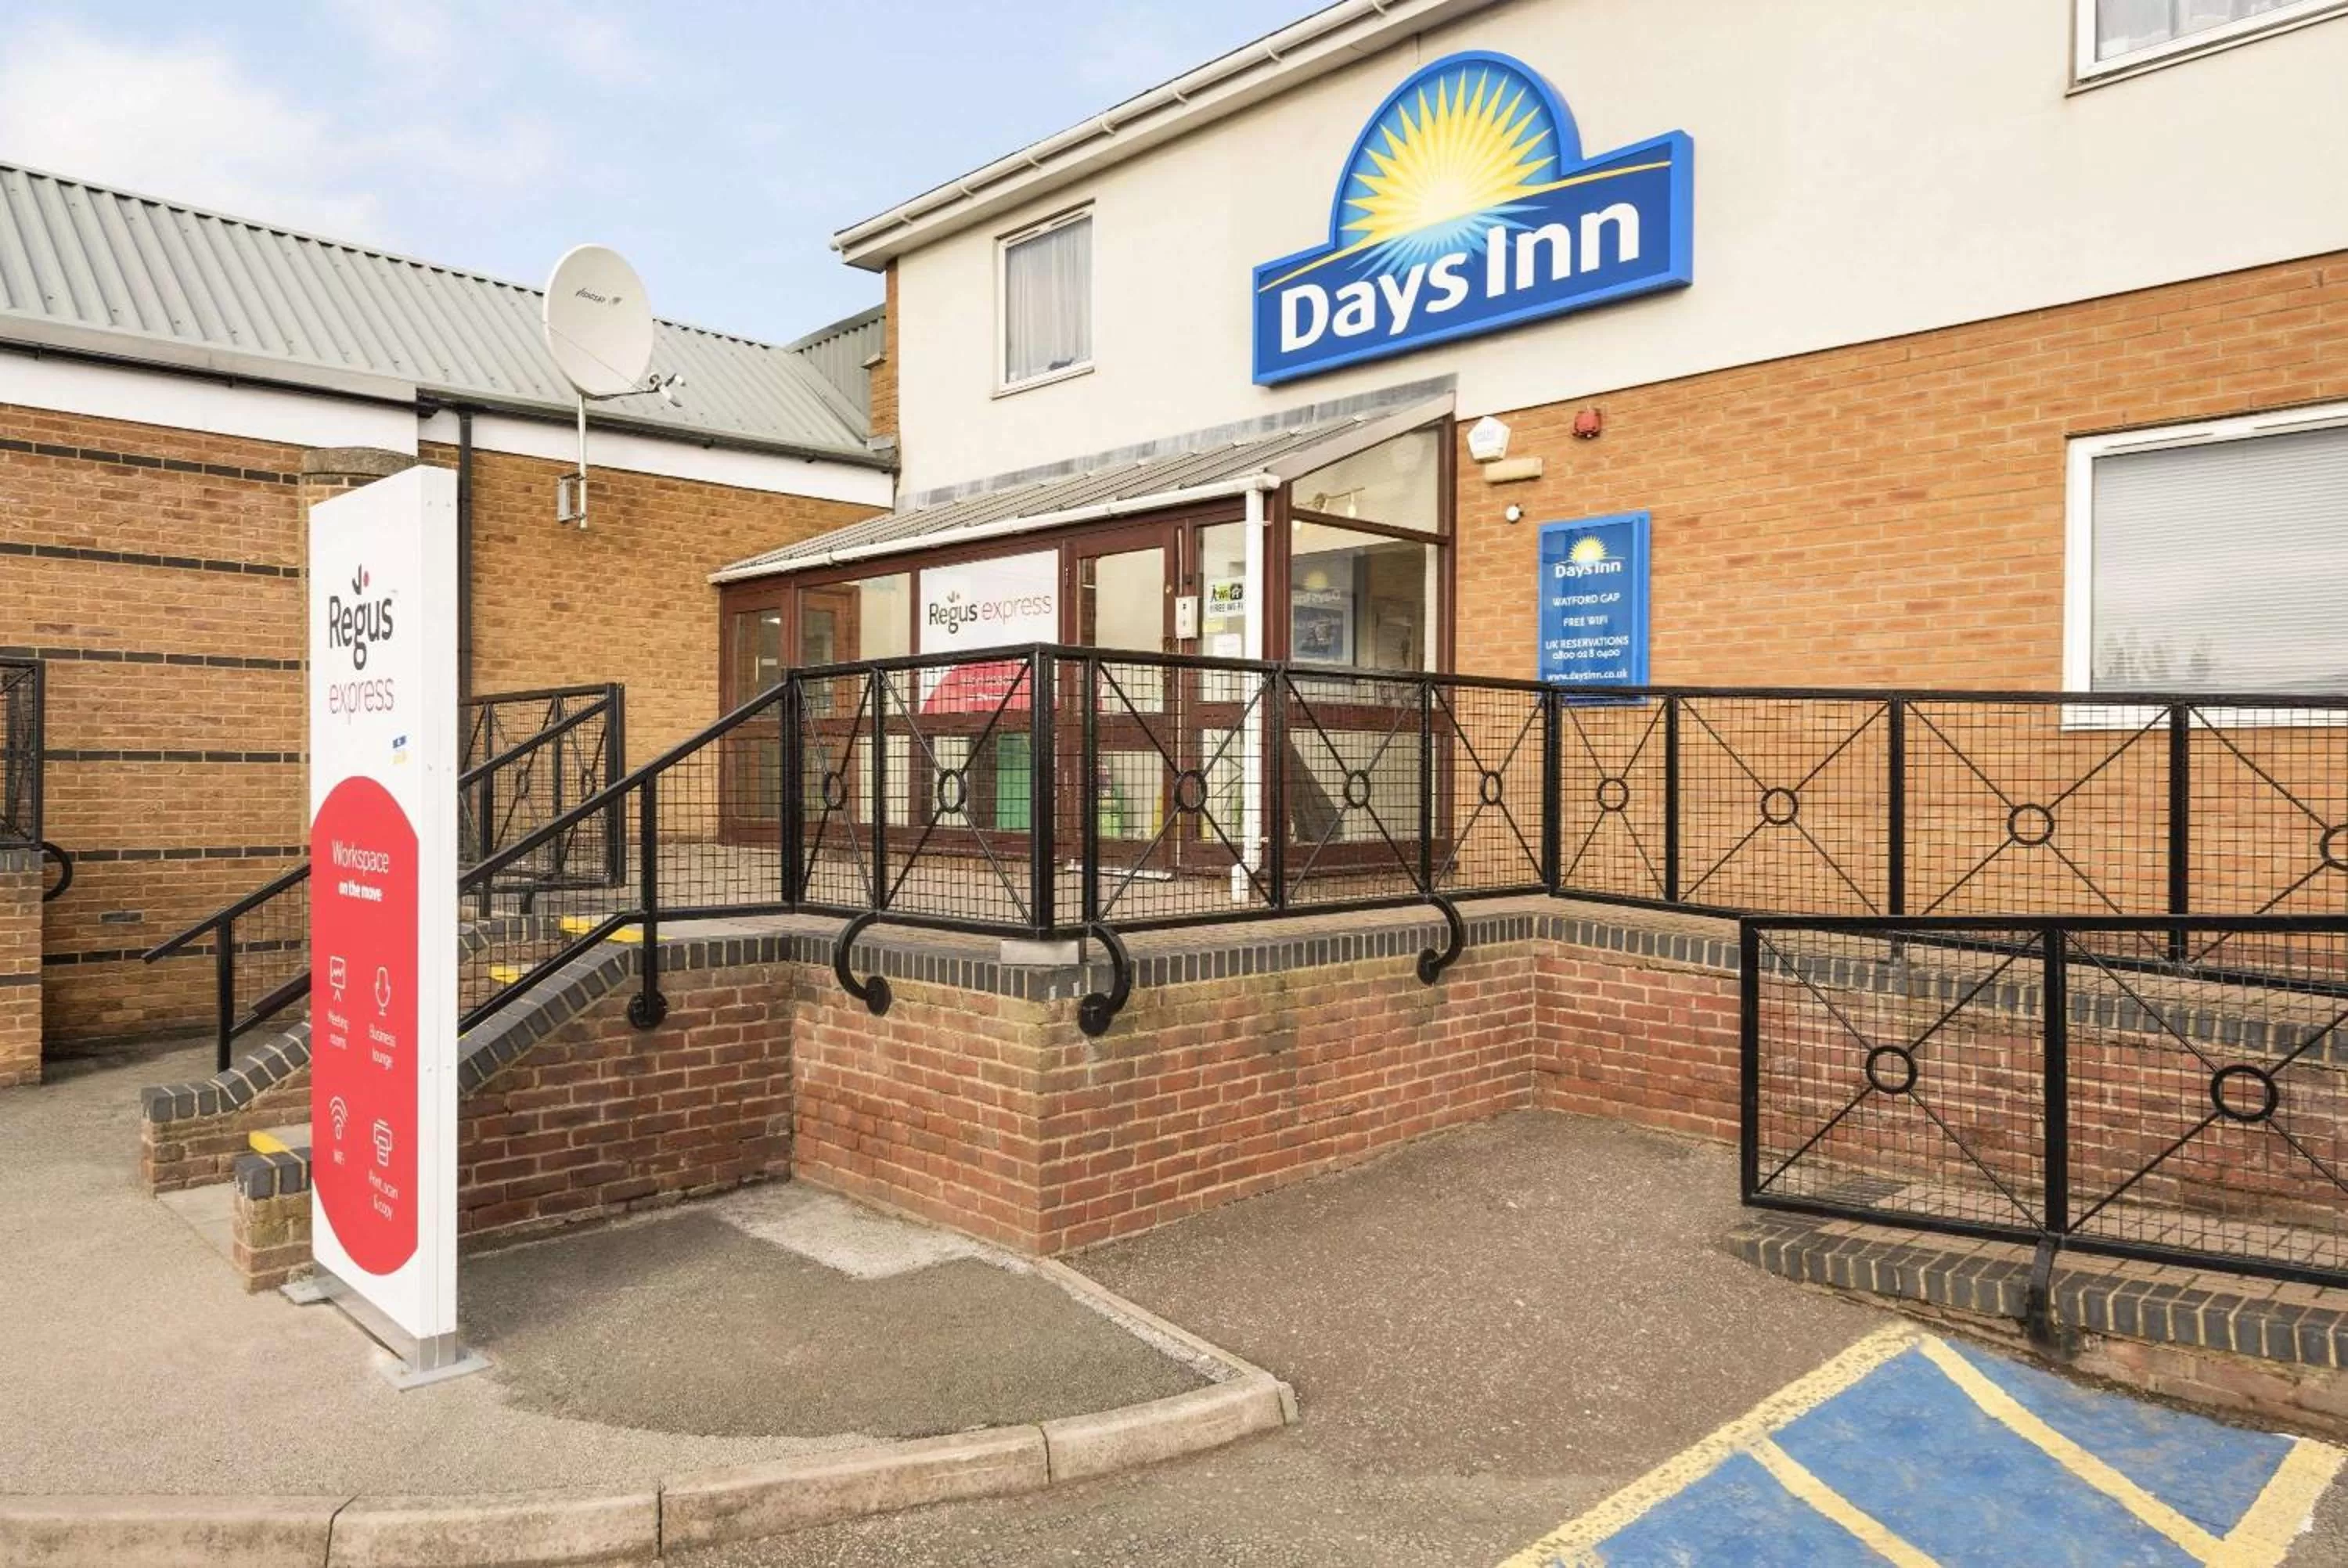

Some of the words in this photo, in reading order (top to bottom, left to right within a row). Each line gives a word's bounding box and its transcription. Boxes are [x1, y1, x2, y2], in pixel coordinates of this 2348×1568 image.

[1280, 252, 1469, 354] Days
[1486, 202, 1640, 298] Inn
[1555, 563, 1592, 578] Days
[1594, 561, 1622, 574] Inn
[1552, 595, 1598, 607] WATFORD
[1600, 592, 1621, 604] GAP
[929, 603, 978, 635] Regus
[981, 594, 1053, 625] express
[1563, 616, 1585, 627] FREE
[329, 595, 394, 671] Regus
[1545, 638, 1558, 650] UK
[1560, 635, 1630, 649] RESERVATIONS
[1552, 650, 1576, 660] 0800
[1596, 648, 1621, 659] 0400
[1546, 668, 1629, 682] www.daysinn.co.uk
[329, 677, 395, 726] express
[331, 839, 390, 877] Workspace
